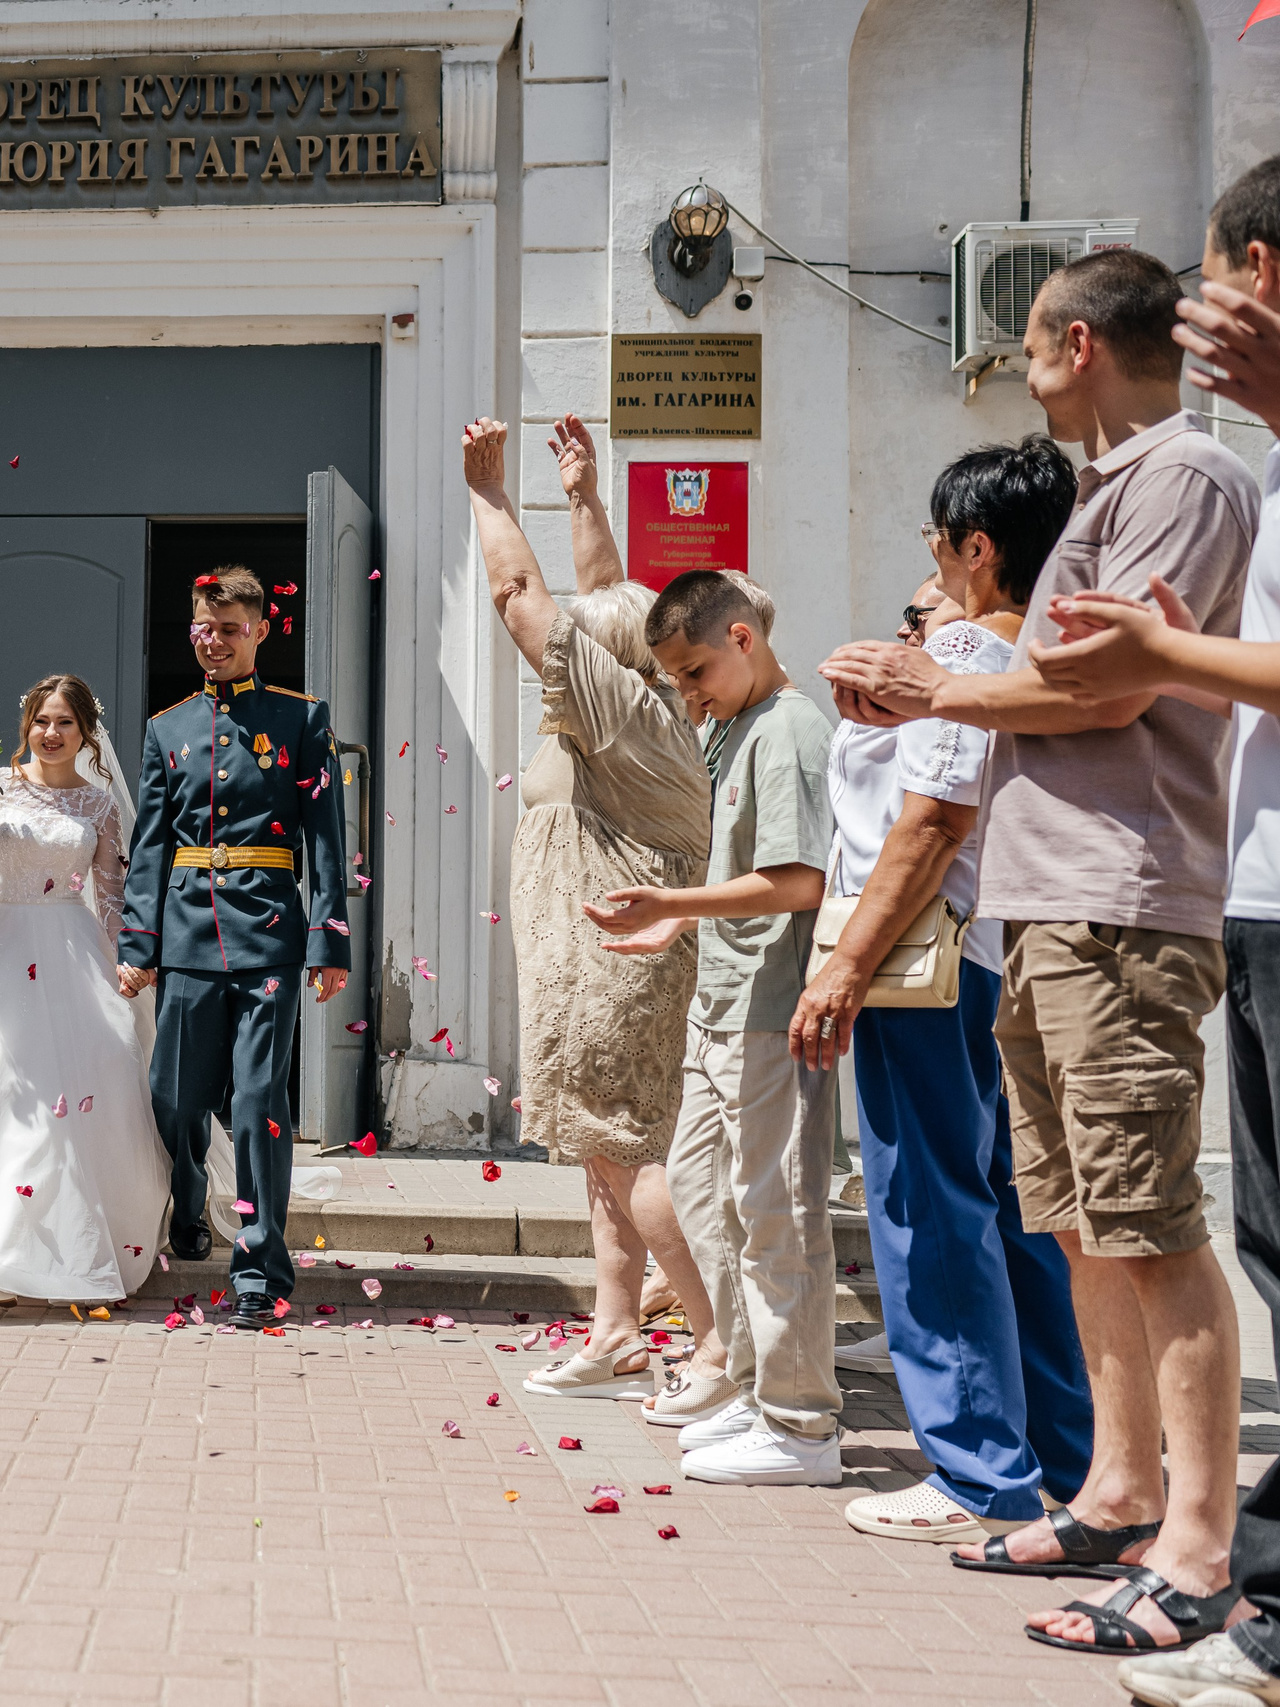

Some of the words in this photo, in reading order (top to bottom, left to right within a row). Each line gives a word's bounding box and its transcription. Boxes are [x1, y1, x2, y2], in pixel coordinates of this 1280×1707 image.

[120, 68, 401, 120] КУЛЬТУРЫ
[165, 131, 438, 183] ГАГАРИНА
[700, 339, 754, 347] БЮДЖЕТНОЕ
[617, 371, 674, 383] ДВОРЕЦ
[681, 371, 756, 382] КУЛЬТУРЫ
[617, 396, 646, 407] им.
[654, 393, 756, 407] ГАГАРИНА
[619, 428, 649, 436] города
[652, 427, 753, 436] Каменск-Шахтинский
[646, 522, 730, 532] ОБЩЕСТВЕННАЯ
[660, 535, 716, 544] ПРИЕМНАЯ
[663, 550, 711, 559] Губернатора
